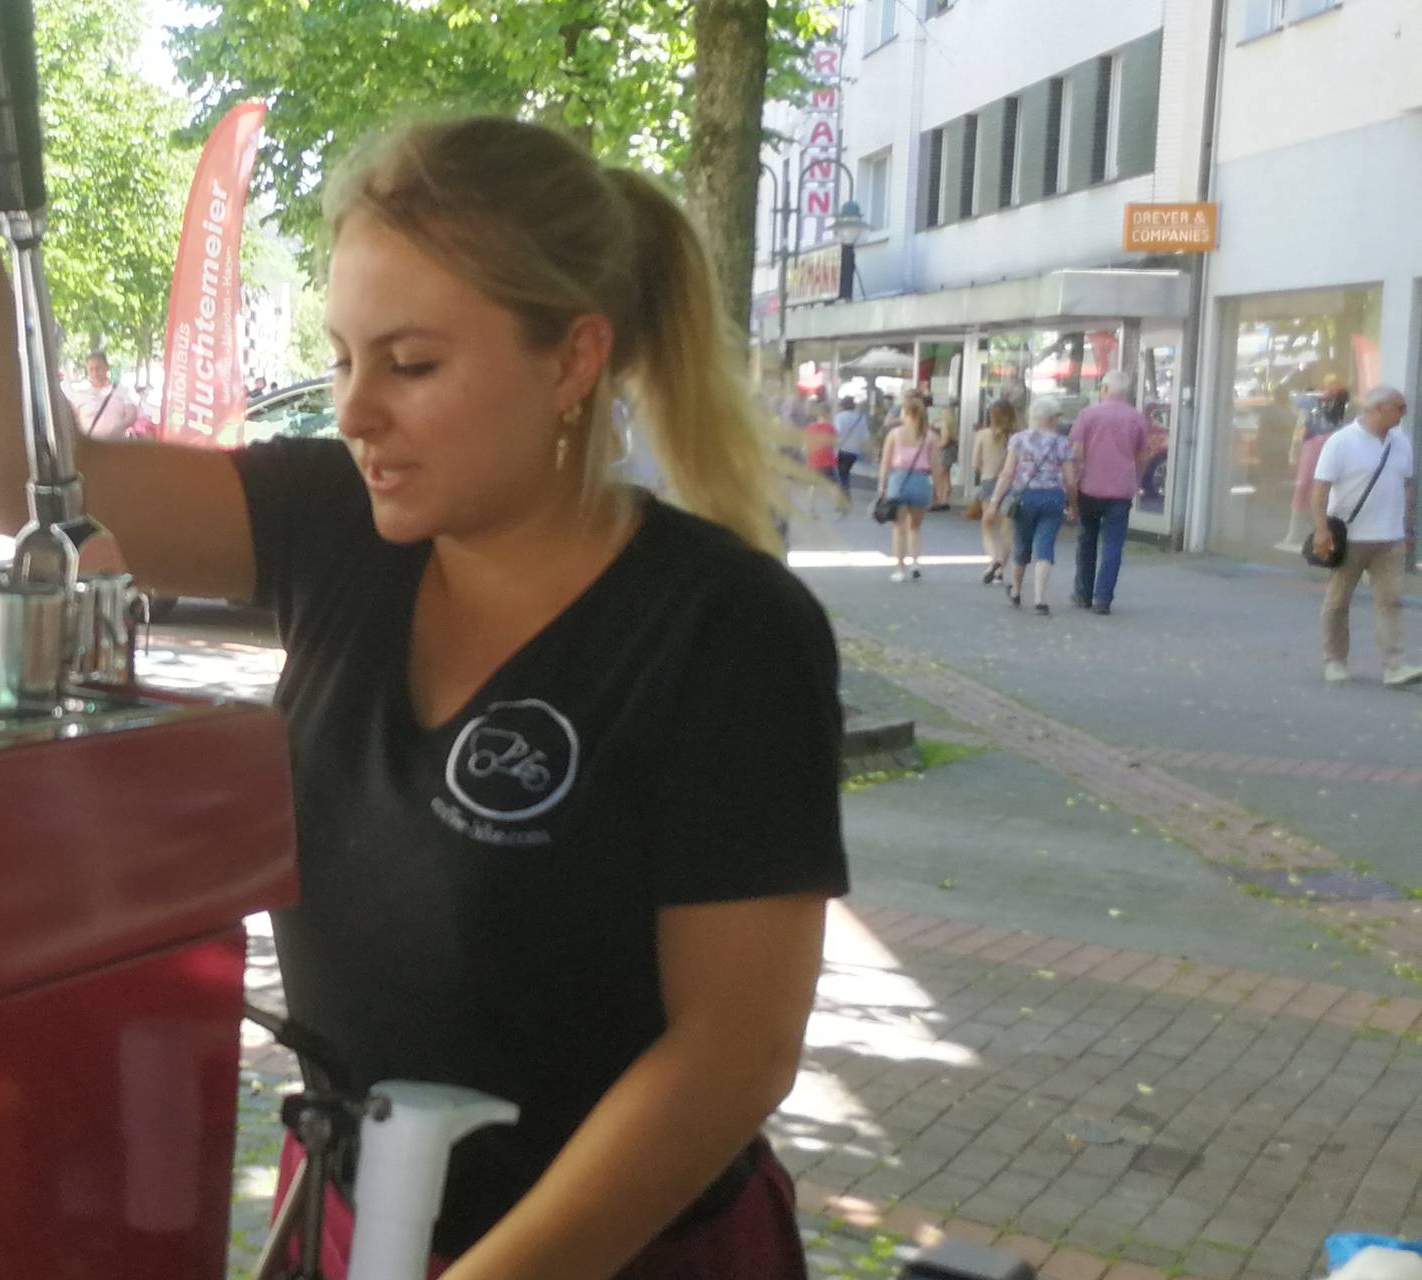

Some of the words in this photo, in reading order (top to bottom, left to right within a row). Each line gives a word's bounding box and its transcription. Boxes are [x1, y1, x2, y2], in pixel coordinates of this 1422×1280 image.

[1133, 210, 1188, 225] DREYER
[1194, 210, 1206, 225] &
[1131, 229, 1209, 243] COMPANIES
[188, 178, 228, 435] Huchtemeier
